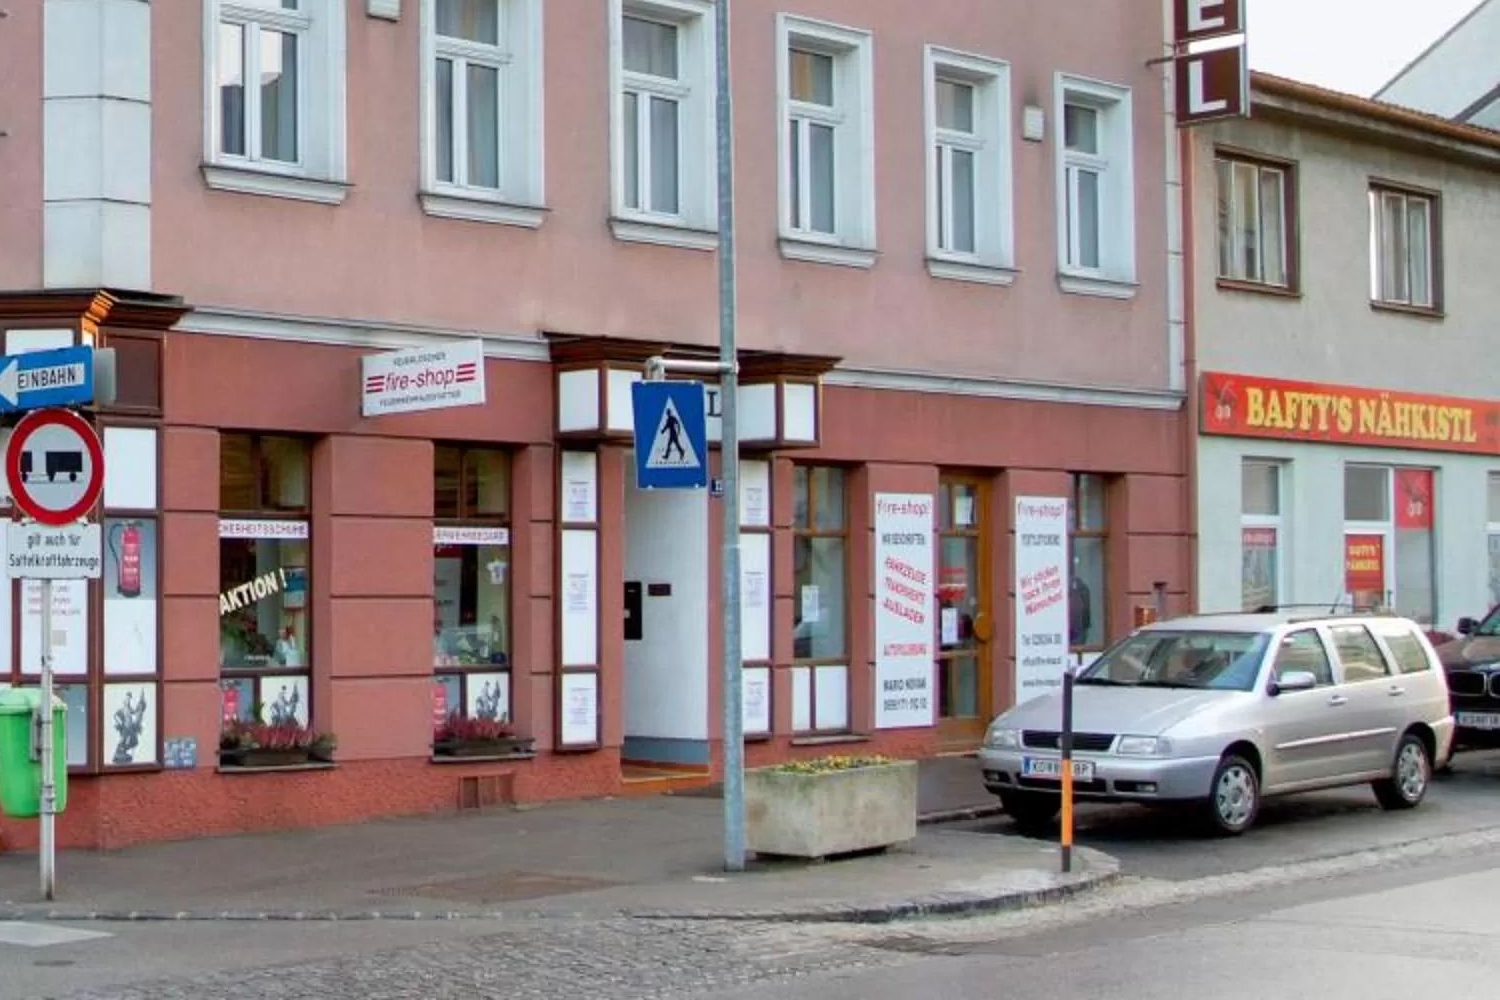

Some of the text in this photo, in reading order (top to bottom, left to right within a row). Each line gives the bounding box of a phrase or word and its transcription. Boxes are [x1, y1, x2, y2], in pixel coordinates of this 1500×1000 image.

[17, 368, 77, 389] EINBAHN
[385, 368, 455, 391] fire-shop
[1245, 387, 1477, 443] BAFFY'S NÄHKISTL
[27, 532, 41, 548] gilt
[44, 532, 65, 546] auch
[9, 553, 99, 570] Sattelkraftfahrzeuge
[219, 573, 278, 615] AKTION
